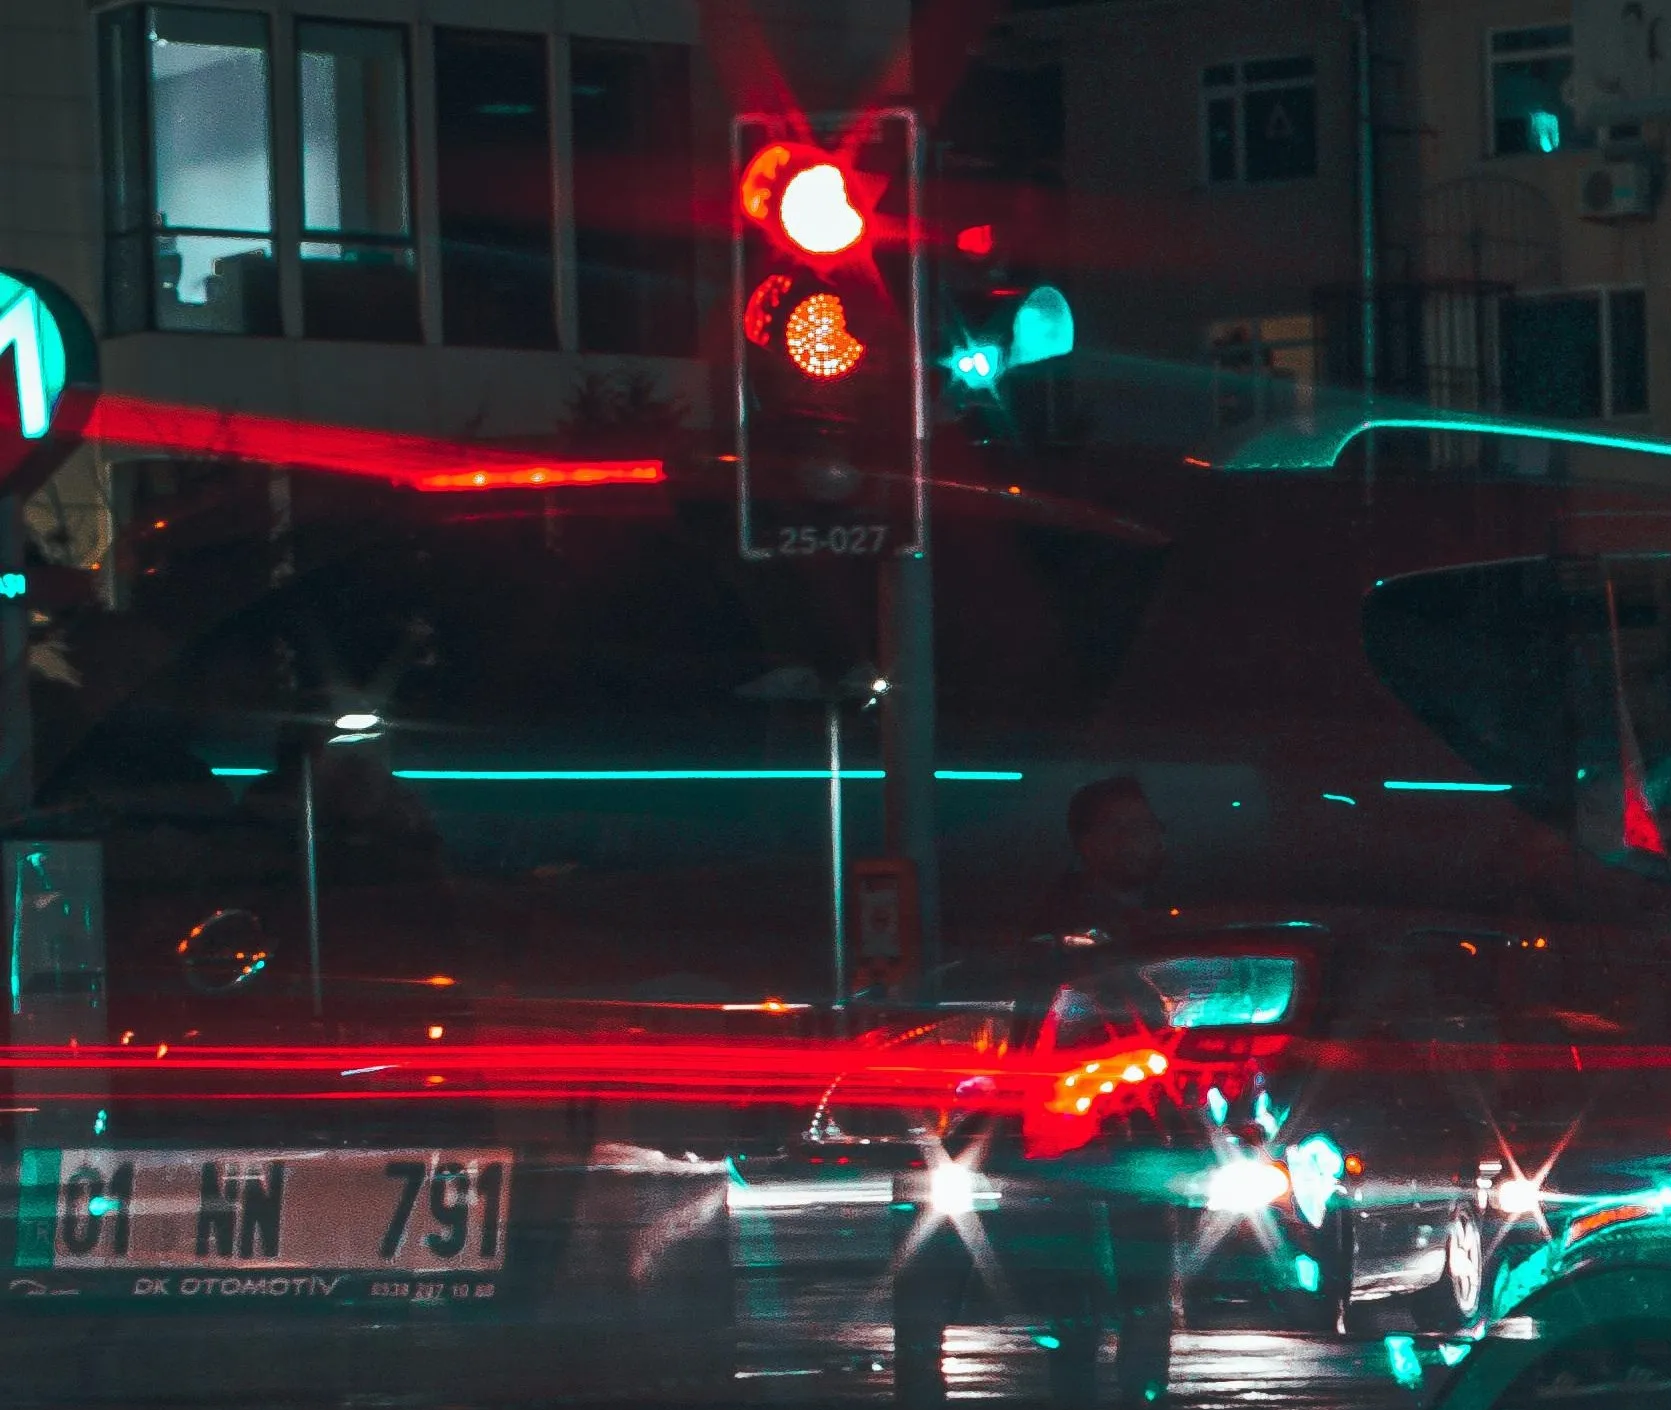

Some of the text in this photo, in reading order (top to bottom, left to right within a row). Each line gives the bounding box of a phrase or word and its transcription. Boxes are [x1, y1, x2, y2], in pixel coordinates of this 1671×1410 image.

[779, 524, 887, 554] 25-027
[380, 1160, 500, 1259] 791
[133, 1278, 170, 1296] DK
